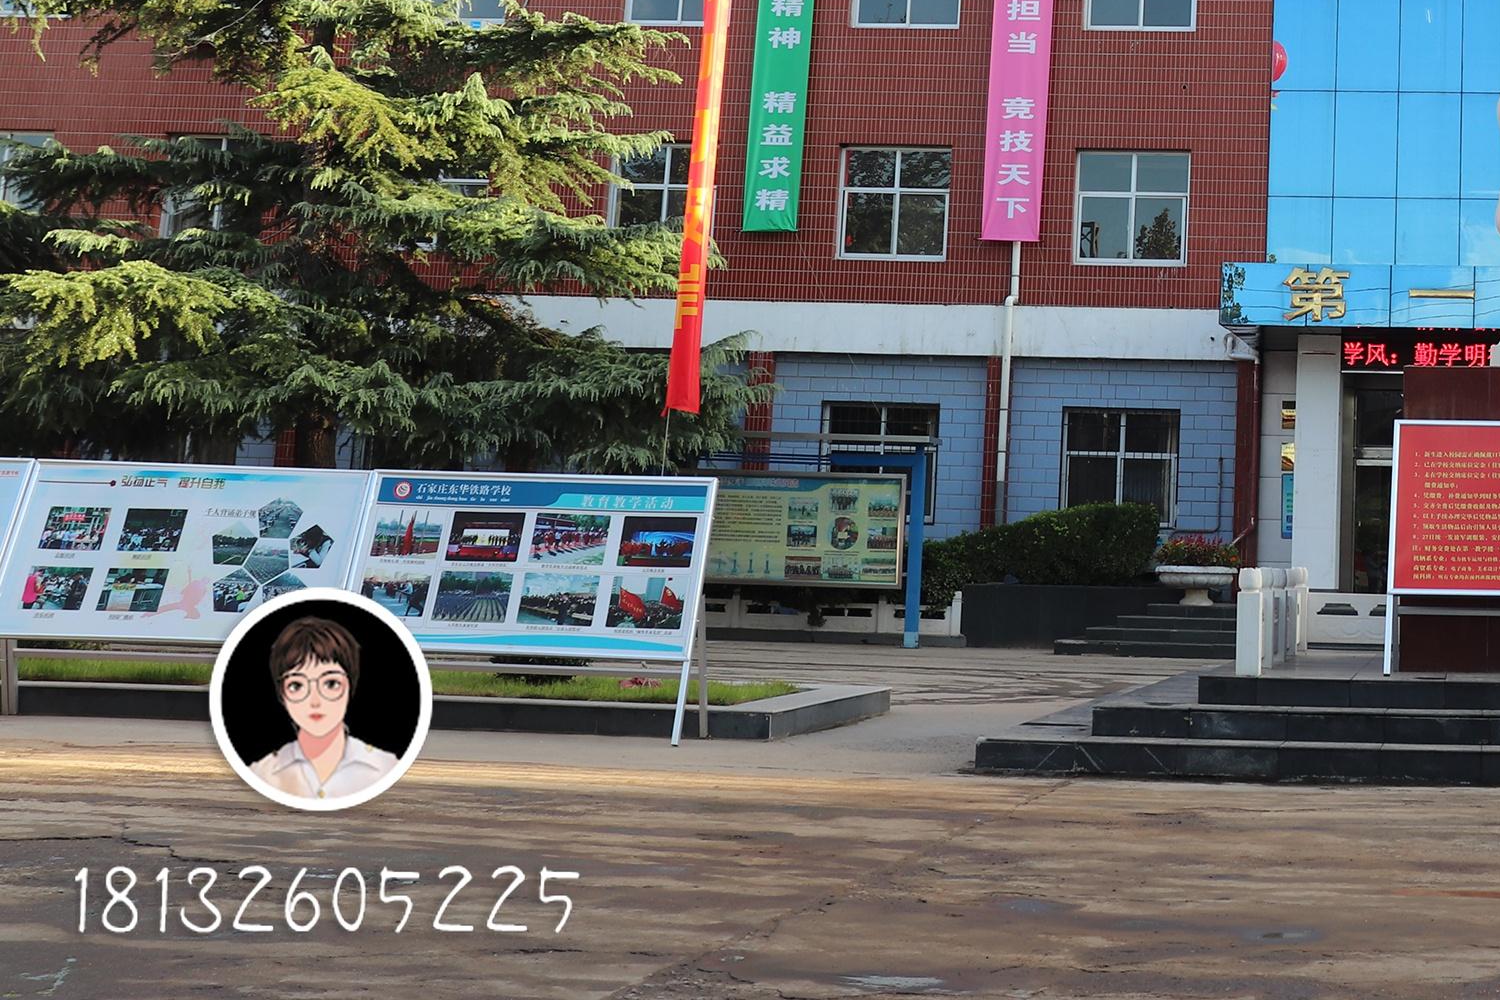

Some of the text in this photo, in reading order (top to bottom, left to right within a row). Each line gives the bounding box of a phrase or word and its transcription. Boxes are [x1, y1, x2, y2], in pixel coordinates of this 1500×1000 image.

[754, 91, 797, 212] 精益求精
[995, 96, 1035, 220] 竞技天下
[1413, 342, 1494, 368] 勤学明
[121, 475, 226, 490] 弘扬正气 提升自我
[417, 482, 512, 496] 石家庄东华铁路学校
[582, 495, 674, 509] 教育教学活动
